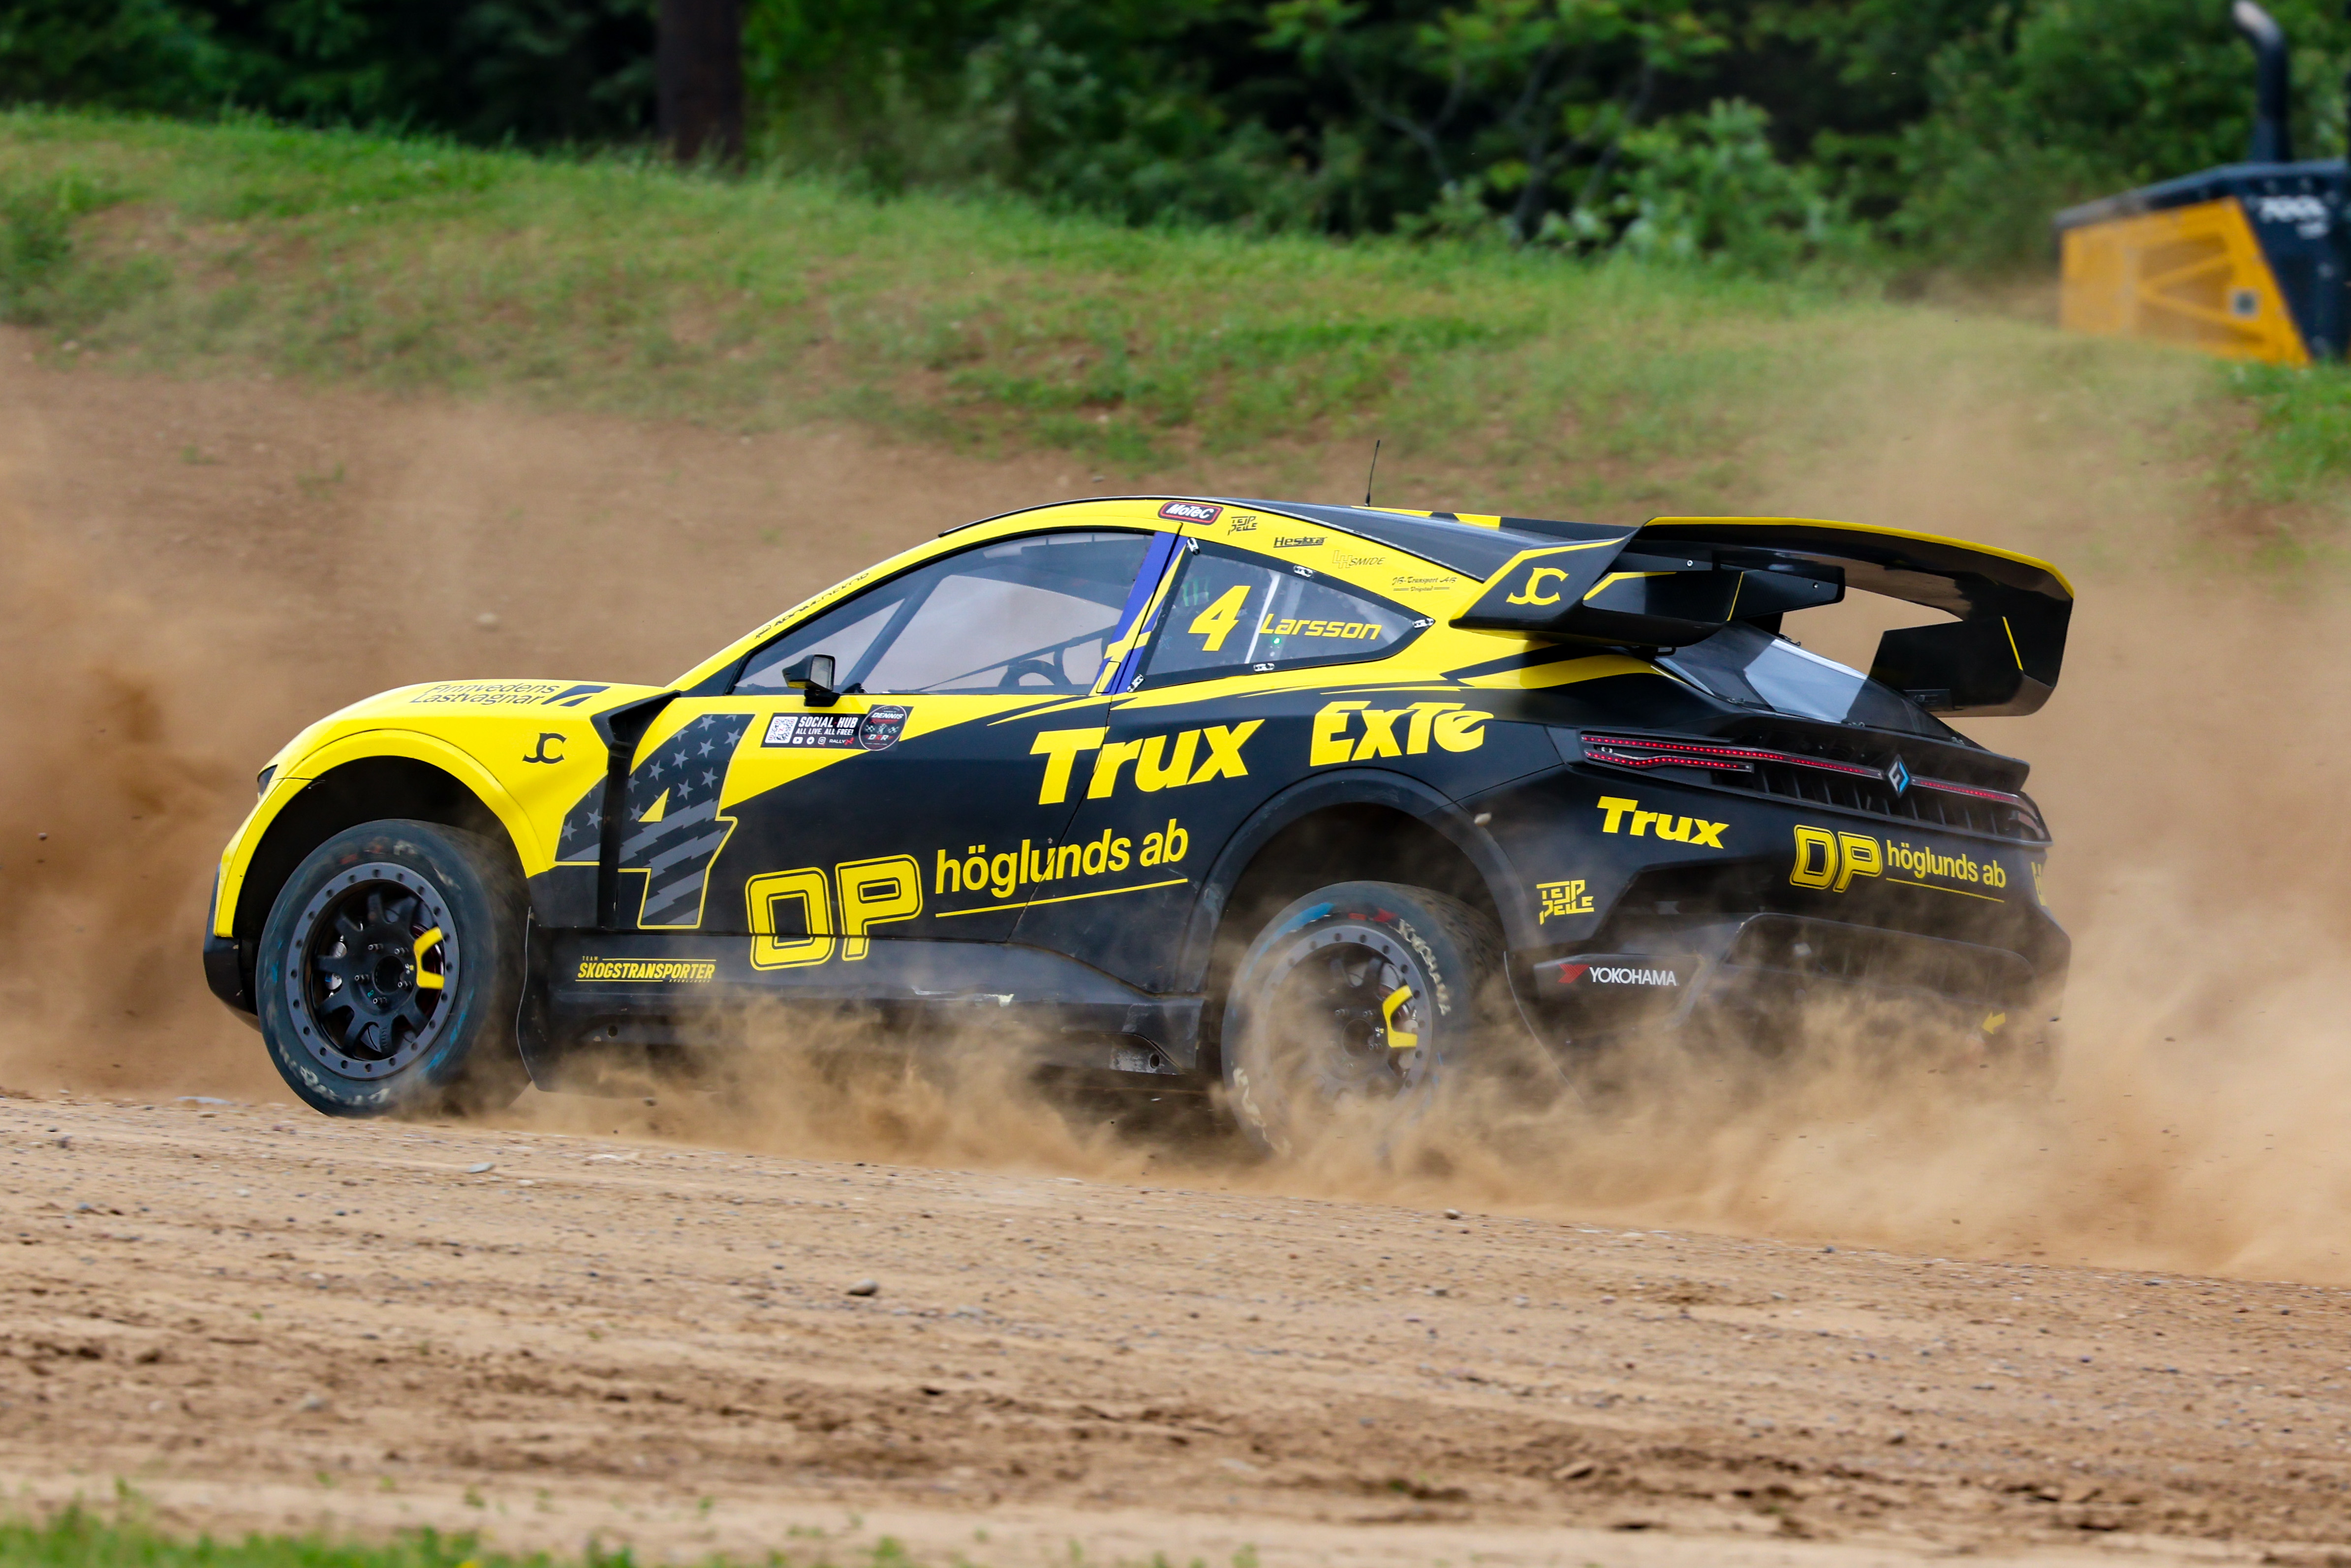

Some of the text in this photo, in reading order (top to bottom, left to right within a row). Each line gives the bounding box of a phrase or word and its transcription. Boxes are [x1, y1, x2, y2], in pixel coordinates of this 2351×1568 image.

[1166, 504, 1214, 519] MoTeC
[1188, 585, 1251, 651] 4
[1259, 614, 1382, 640] Larsson
[409, 693, 545, 705] Lastvagnar
[423, 683, 560, 694] Finnvedens
[798, 716, 834, 727] SOCIAL
[836, 717, 858, 728] HUB
[1029, 719, 1265, 805] Trux
[552, 712, 738, 930] 4
[1597, 796, 1730, 849] Trux
[936, 829, 1131, 898] höglunds
[1140, 818, 1188, 867] ab
[1887, 840, 1979, 882] höglunds
[1982, 860, 2006, 888] ab
[578, 962, 715, 978] SKOGSTRANSPORTER
[1589, 967, 1677, 986] YOKOHAMA
